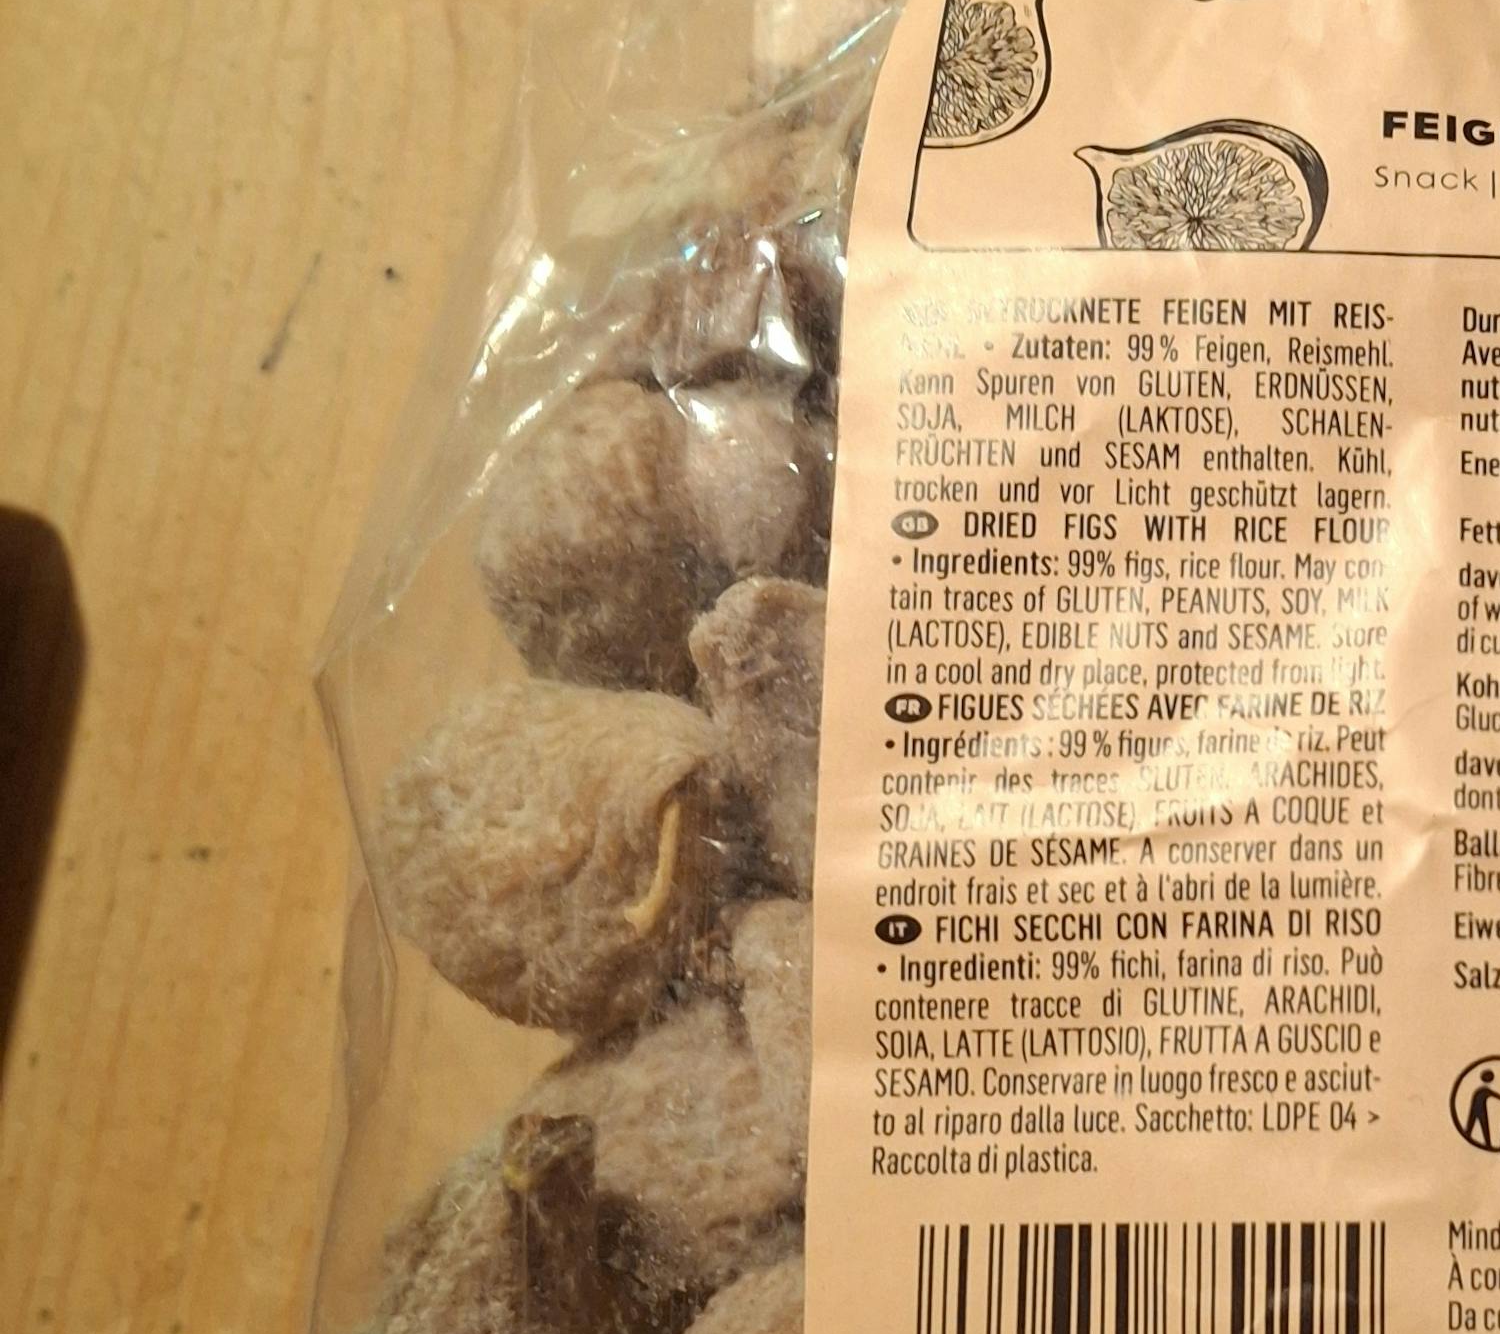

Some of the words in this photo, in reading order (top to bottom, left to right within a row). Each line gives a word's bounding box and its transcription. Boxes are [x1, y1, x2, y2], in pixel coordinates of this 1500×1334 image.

[1374, 164, 1479, 192] Snack
[976, 367, 1055, 401] Spuren
[1076, 374, 1116, 397] von
[1138, 369, 1231, 402] GLUTEN,
[1255, 366, 1393, 407] ERDNÜSSEN,
[1006, 402, 1076, 433] MILCH
[1118, 404, 1239, 441] (LAKTOSE),
[1281, 407, 1393, 439] SCHALEN-
[894, 474, 978, 503] trocken
[999, 475, 1040, 504] und
[1059, 482, 1095, 505] vor
[1115, 477, 1171, 507] Licht
[1190, 479, 1298, 514] geschützt
[1317, 480, 1391, 515] lagern.
[964, 510, 1037, 539] DRIED
[1064, 513, 1118, 541] FIGS
[1144, 514, 1207, 543] WITH
[1234, 515, 1288, 543] RICE
[875, 876, 957, 908] endroit
[966, 875, 1018, 906] frais
[1026, 878, 1050, 905] et
[1057, 881, 1096, 905] sec
[1104, 876, 1128, 904] et
[1136, 872, 1148, 904] à
[1158, 871, 1215, 903] l'abri
[1224, 871, 1251, 902] de
[1260, 871, 1280, 901] la
[1290, 869, 1382, 900] lumière.
[936, 914, 999, 944] FICHI
[1013, 912, 1102, 943] SECCHI
[1116, 911, 1167, 941] CON
[1181, 909, 1275, 939] FARINA
[1288, 908, 1311, 938] DI
[1325, 907, 1382, 937] RISO
[900, 951, 1041, 989] Ingredienti:
[1110, 948, 1166, 982] fichi,
[1177, 947, 1242, 979] farina
[1252, 946, 1273, 978] di
[1283, 946, 1330, 977] riso.
[1341, 944, 1384, 976] Può
[875, 993, 990, 1022] contenere
[1010, 992, 1082, 1020] tracce
[1102, 987, 1122, 1018] di
[1143, 986, 1244, 1018] GLUTINE,
[1264, 983, 1381, 1017] ARACHIDI,
[875, 1029, 935, 1062] SOIA,
[943, 1028, 1014, 1059] LATTE
[1021, 1026, 1152, 1064] (LATTOSIO),
[1159, 1024, 1248, 1056] FRUTTA
[1254, 1024, 1271, 1054] A
[1277, 1022, 1362, 1055] GUSCIO
[1368, 1029, 1382, 1054] e
[871, 1144, 972, 1176] Raccolta
[977, 1143, 999, 1175] di
[1004, 1142, 1098, 1180] plastica.
[1447, 1252, 1464, 1291] À
[1448, 1300, 1477, 1332] Da
